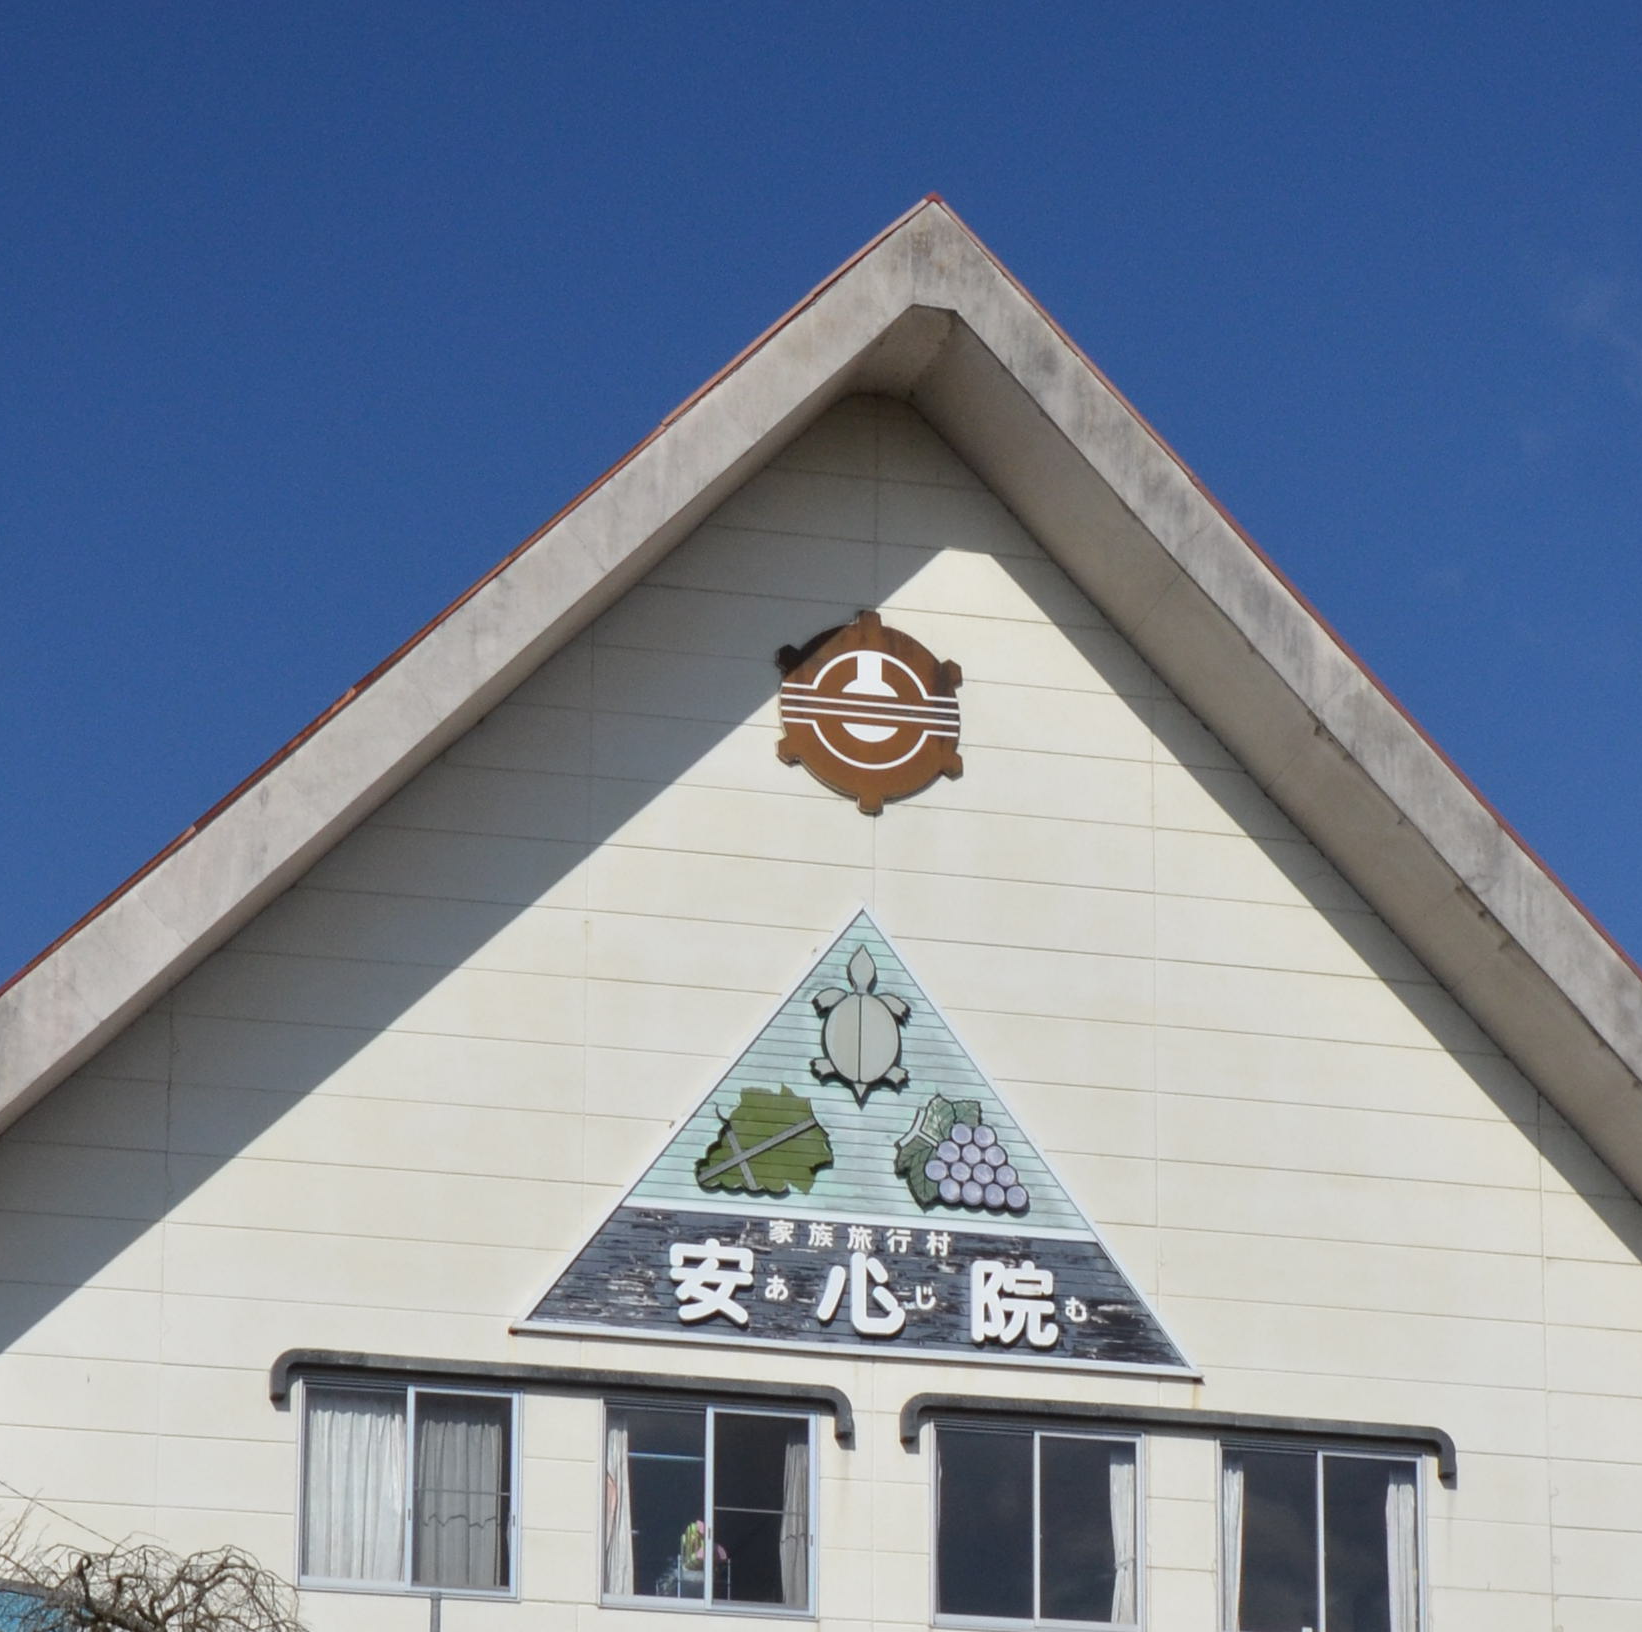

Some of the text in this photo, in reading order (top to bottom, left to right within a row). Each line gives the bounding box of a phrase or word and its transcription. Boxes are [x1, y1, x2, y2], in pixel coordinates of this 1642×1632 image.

[768, 1218, 951, 1257] 家族旅行村
